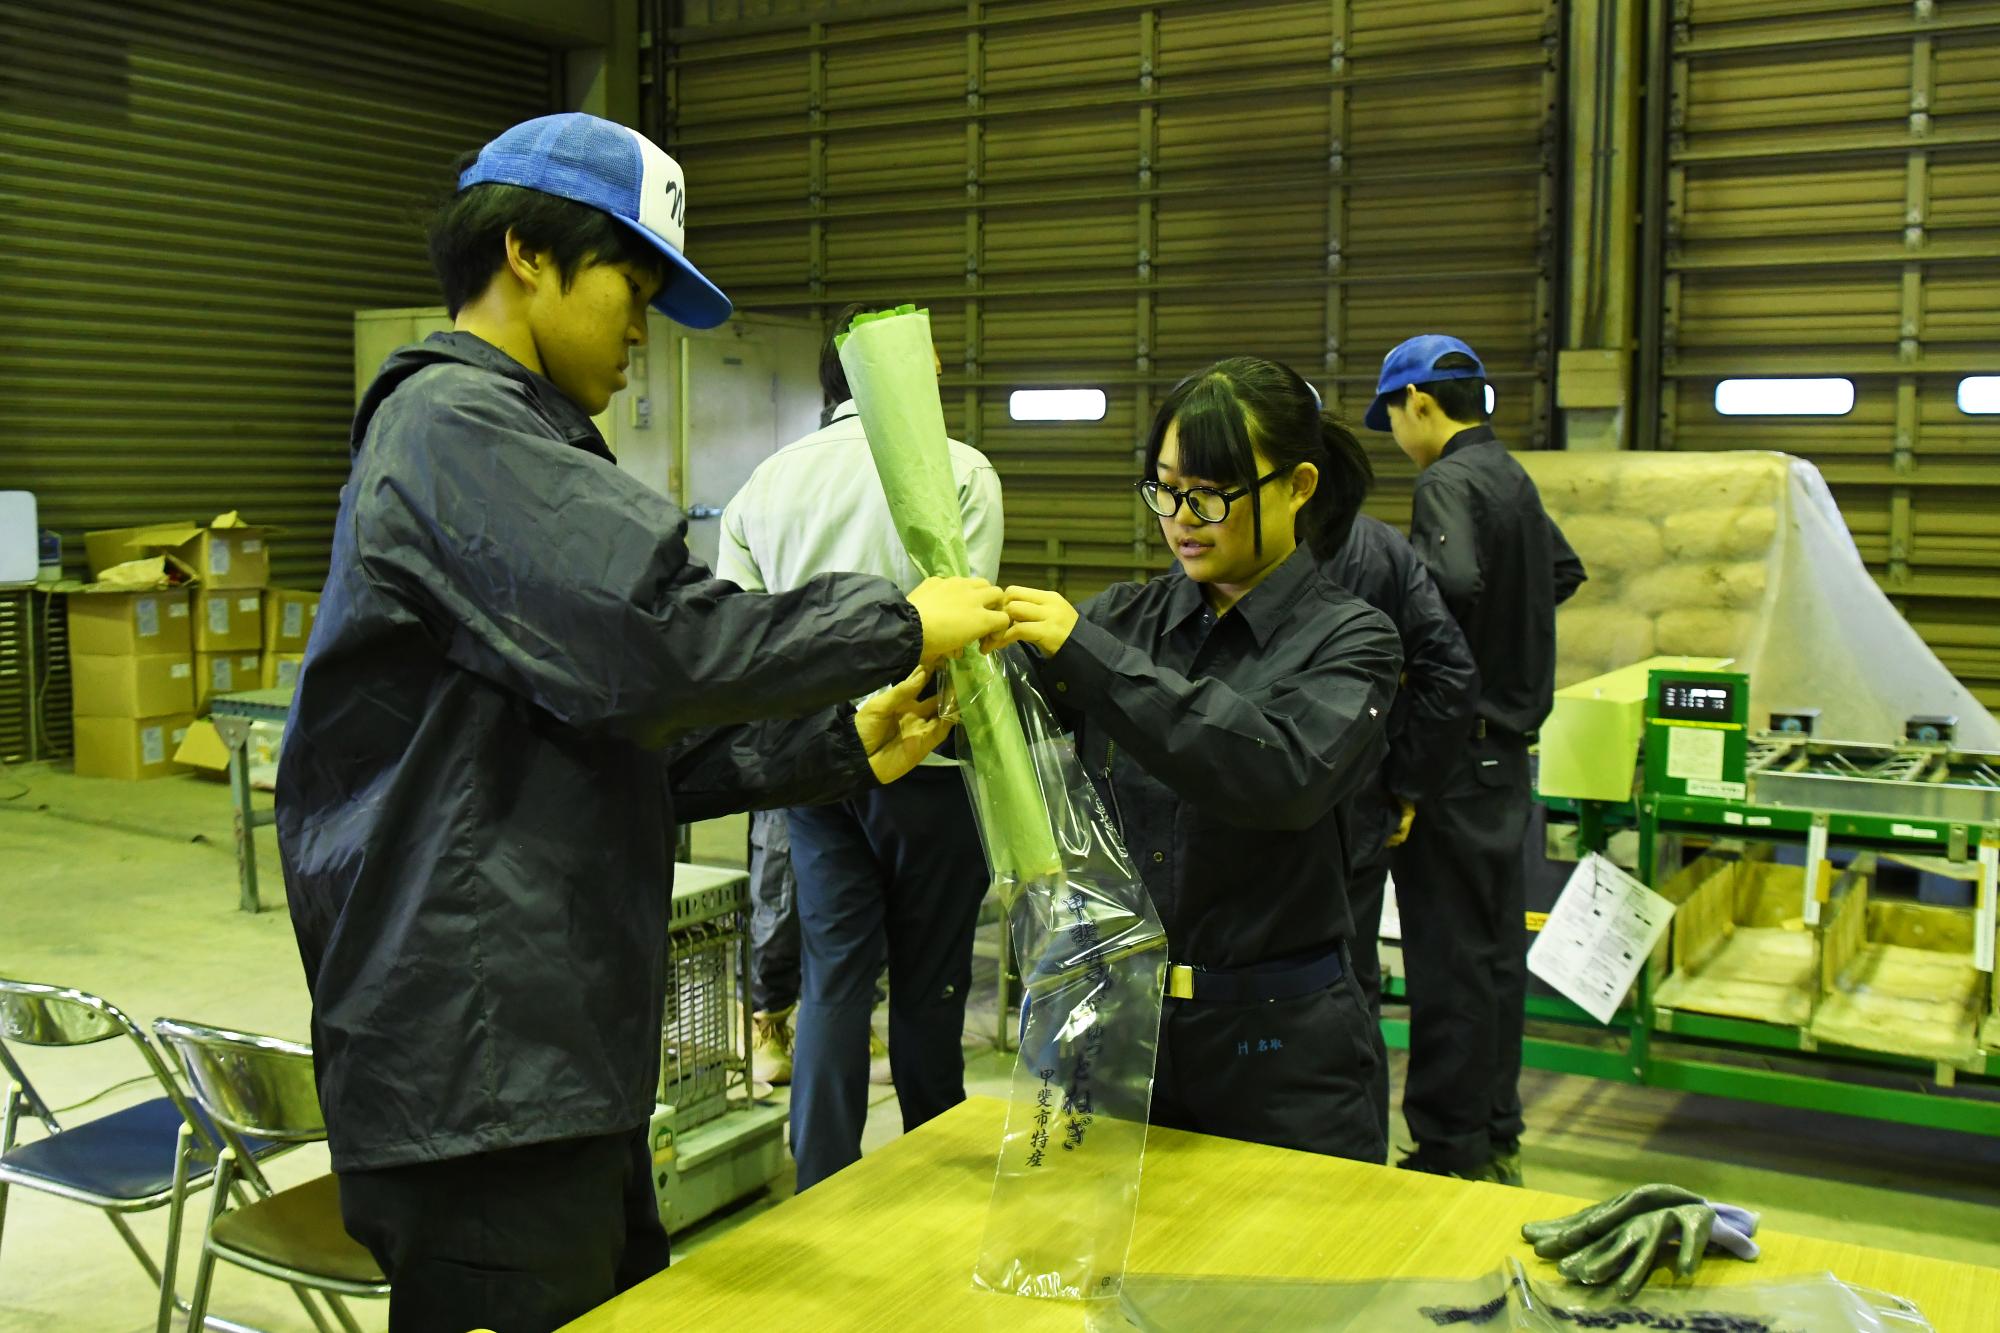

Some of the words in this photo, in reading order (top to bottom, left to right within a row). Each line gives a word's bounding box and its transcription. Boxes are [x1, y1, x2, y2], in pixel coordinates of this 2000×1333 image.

[1024, 1069, 1055, 1167] 甲斐市特産
